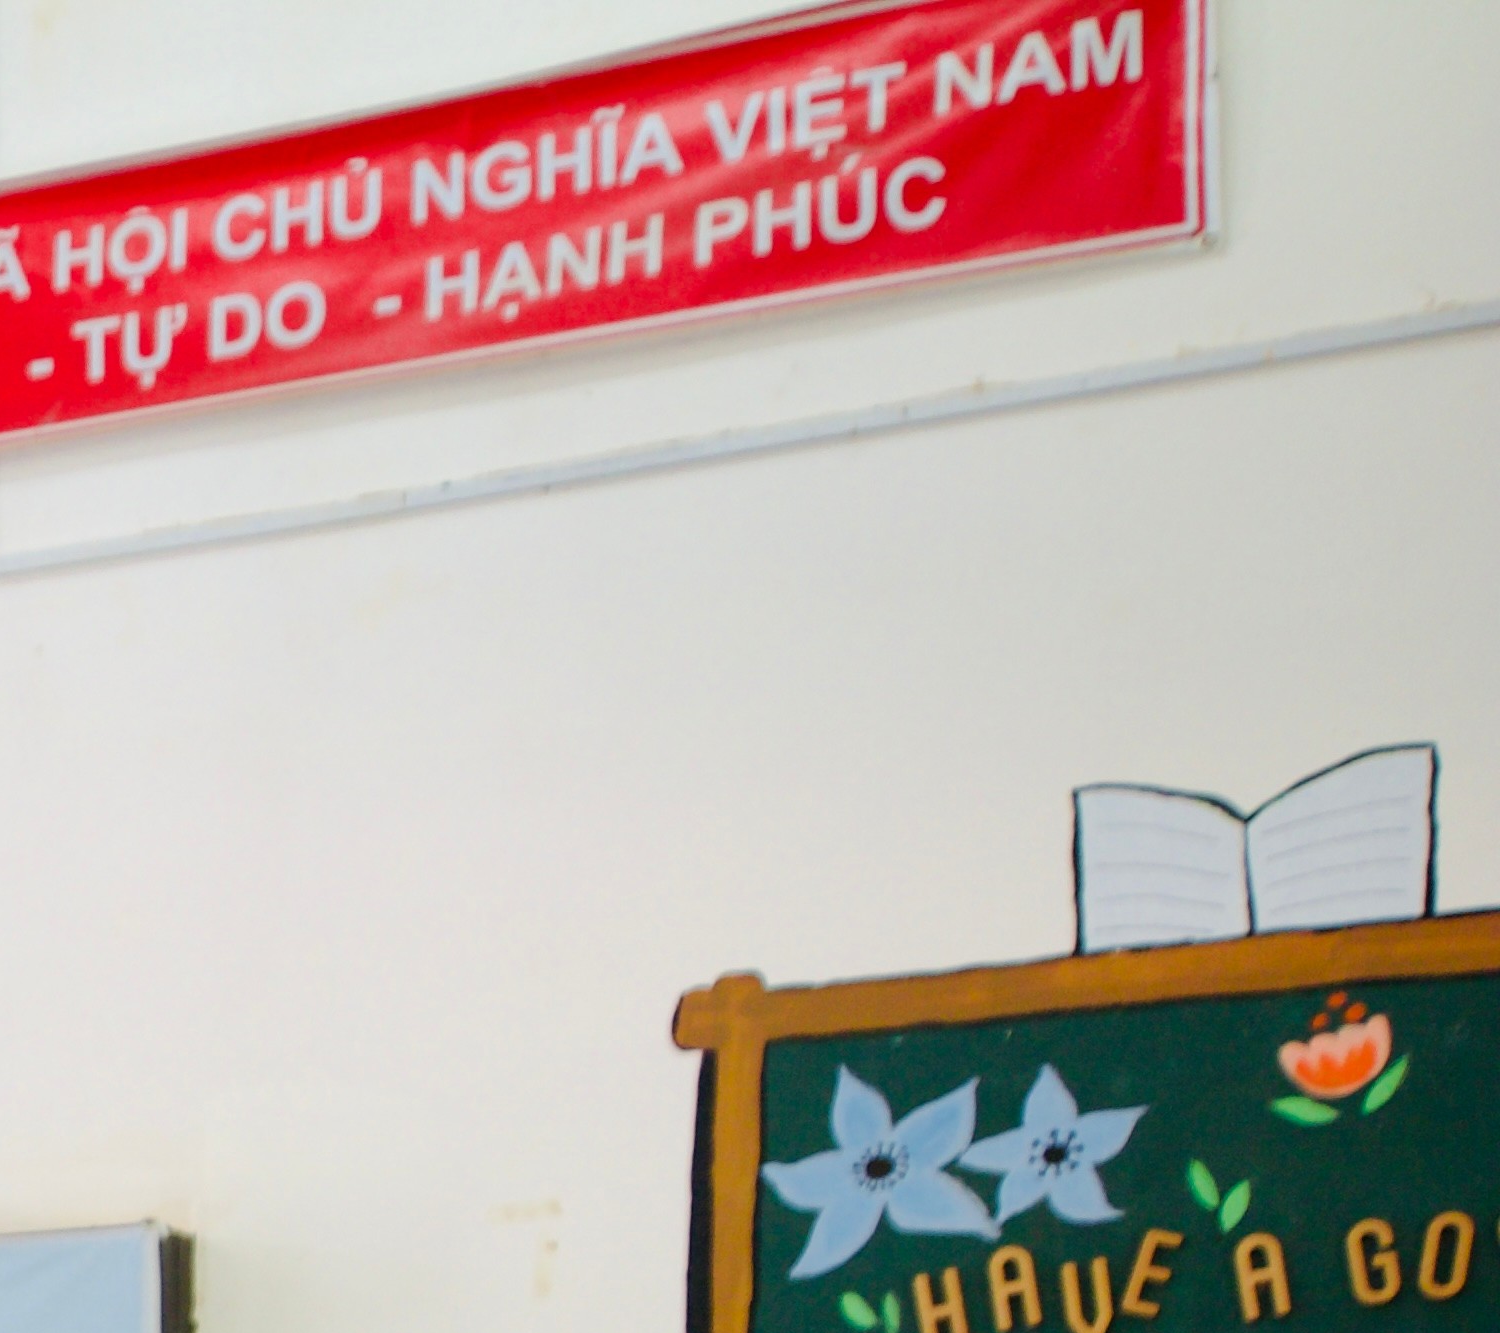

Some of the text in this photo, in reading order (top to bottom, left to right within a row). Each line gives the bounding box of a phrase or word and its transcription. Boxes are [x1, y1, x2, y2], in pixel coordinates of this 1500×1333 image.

[52, 207, 189, 293] HỘI
[214, 156, 382, 259] CHỦ
[411, 104, 684, 224] NGHĨA
[706, 62, 905, 161] VIỆT
[935, 8, 1145, 116] NAM
[71, 304, 186, 387] TỰ
[209, 281, 327, 363] DO
[424, 212, 664, 319] HẠNH
[693, 153, 948, 267] PHÚC
[1234, 1230, 1290, 1322] A
